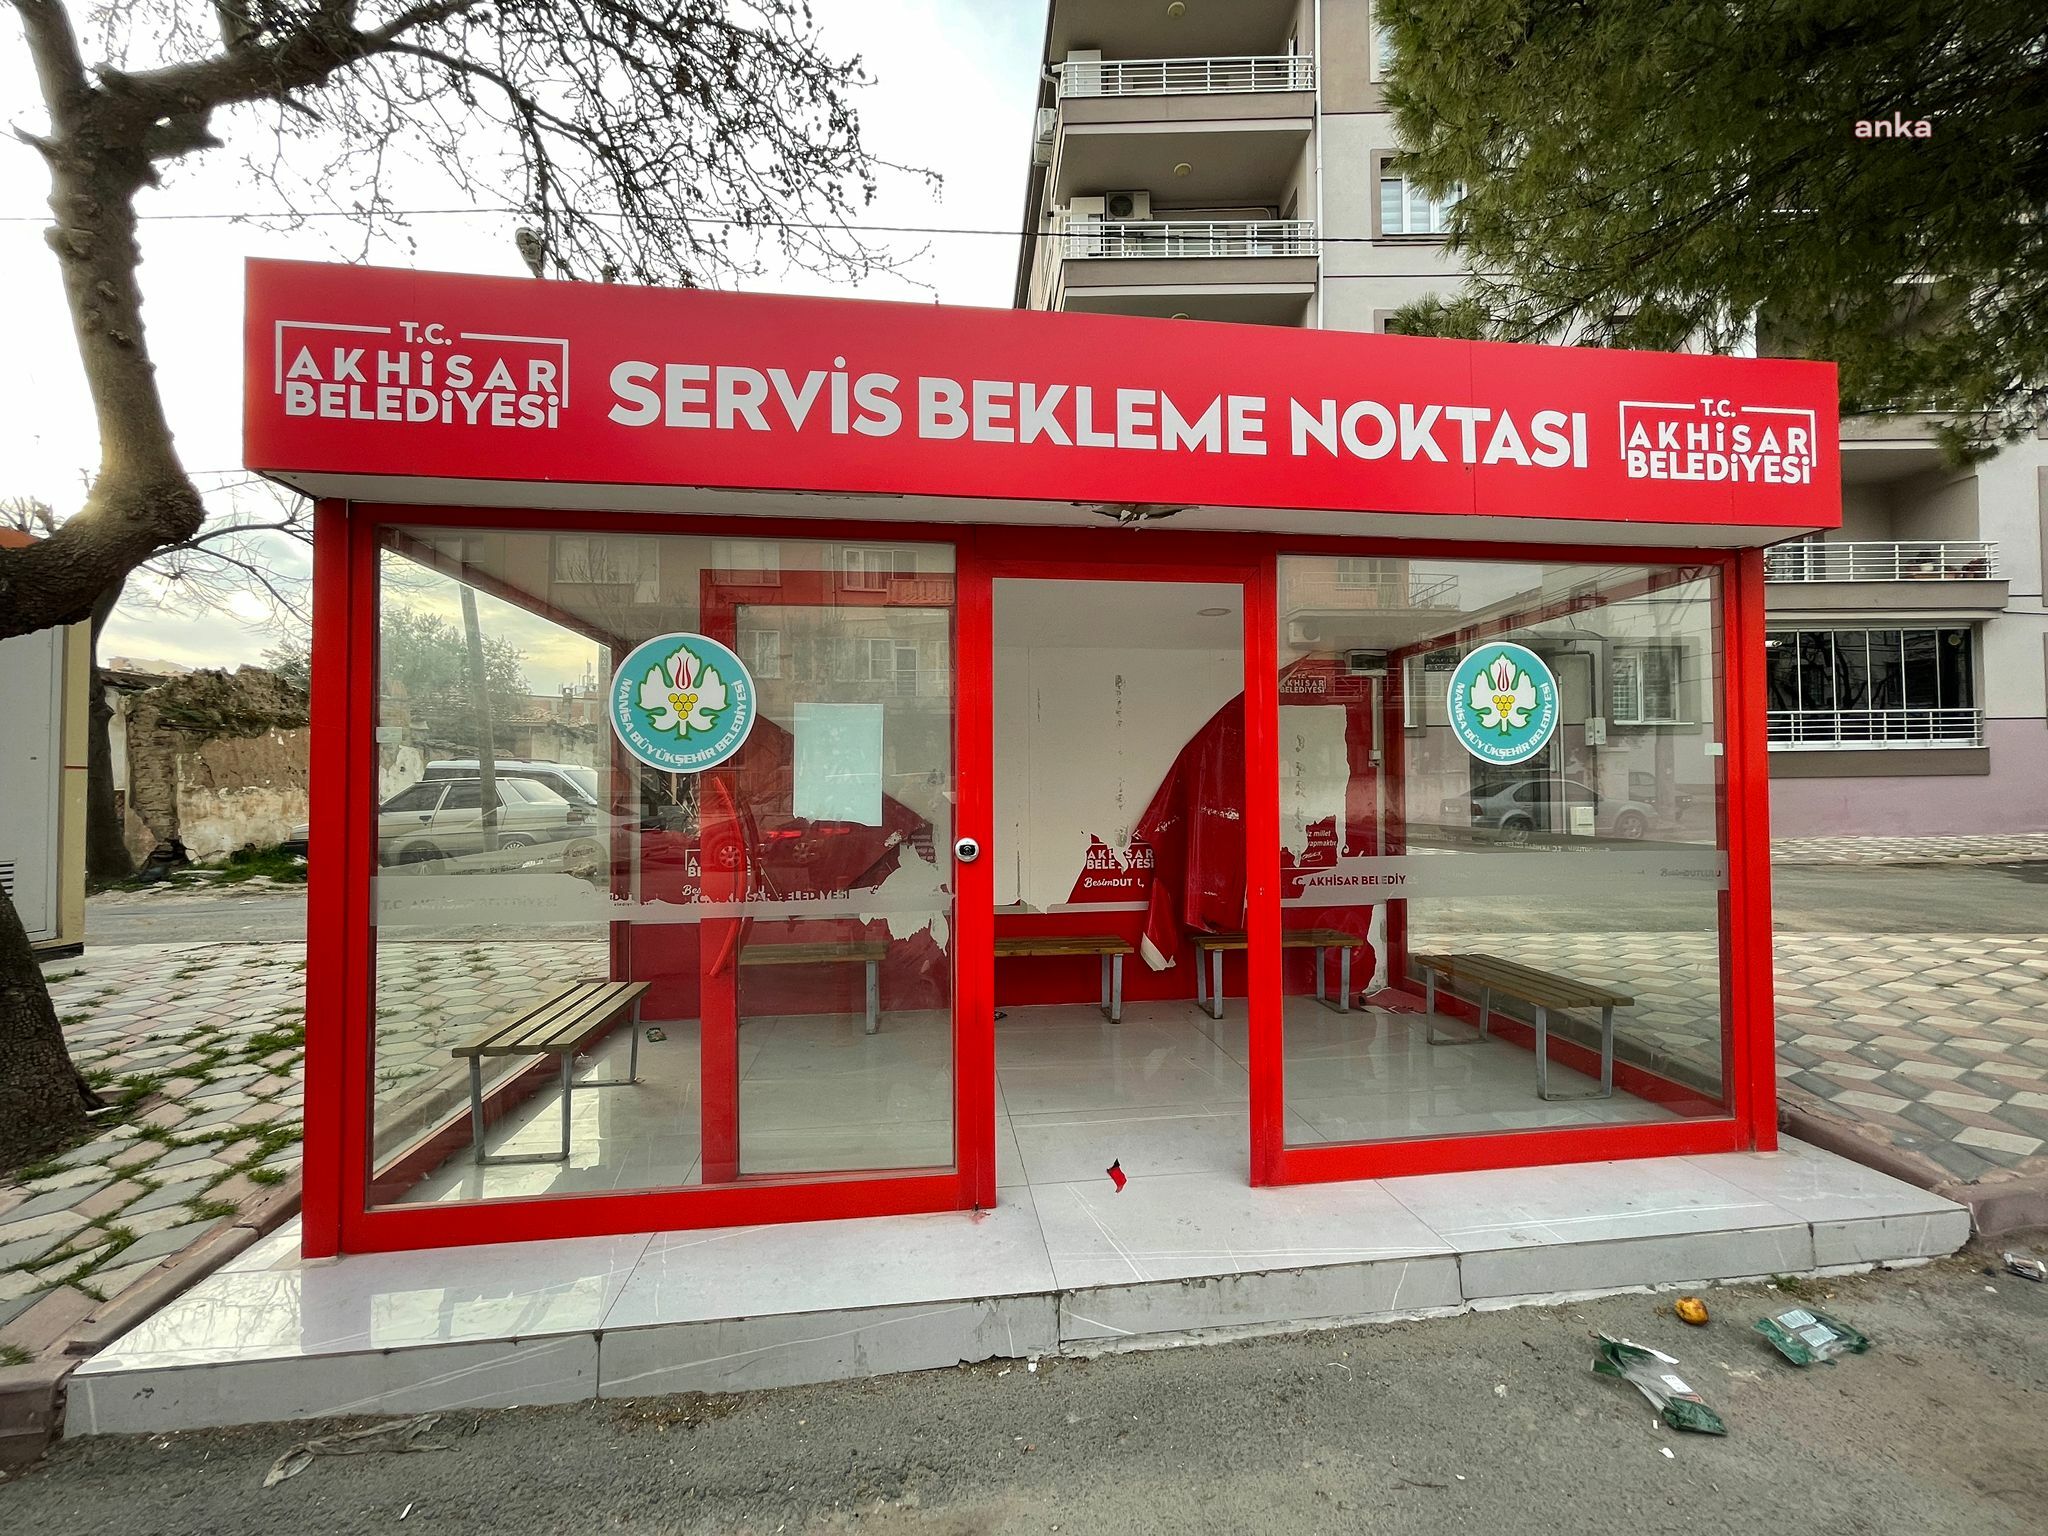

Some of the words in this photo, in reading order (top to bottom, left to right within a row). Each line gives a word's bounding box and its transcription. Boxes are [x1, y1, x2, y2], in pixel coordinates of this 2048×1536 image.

[399, 321, 453, 346] T.C.
[607, 356, 903, 437] SERVİS
[918, 376, 1268, 455] BEKLEME
[1290, 396, 1588, 468] NOKTASI
[1700, 398, 1737, 418] T.C.
[618, 677, 634, 732] MANİSA
[630, 732, 717, 767] BÜYÜKŞEHİR
[717, 679, 747, 753] BELEDİYESİ
[1454, 681, 1468, 730] MANİSA
[1464, 729, 1531, 760] BÜYÜKŞEHİR
[1530, 682, 1553, 746] BELEDİYESİ
[1086, 859, 1155, 870] BELEYESİ
